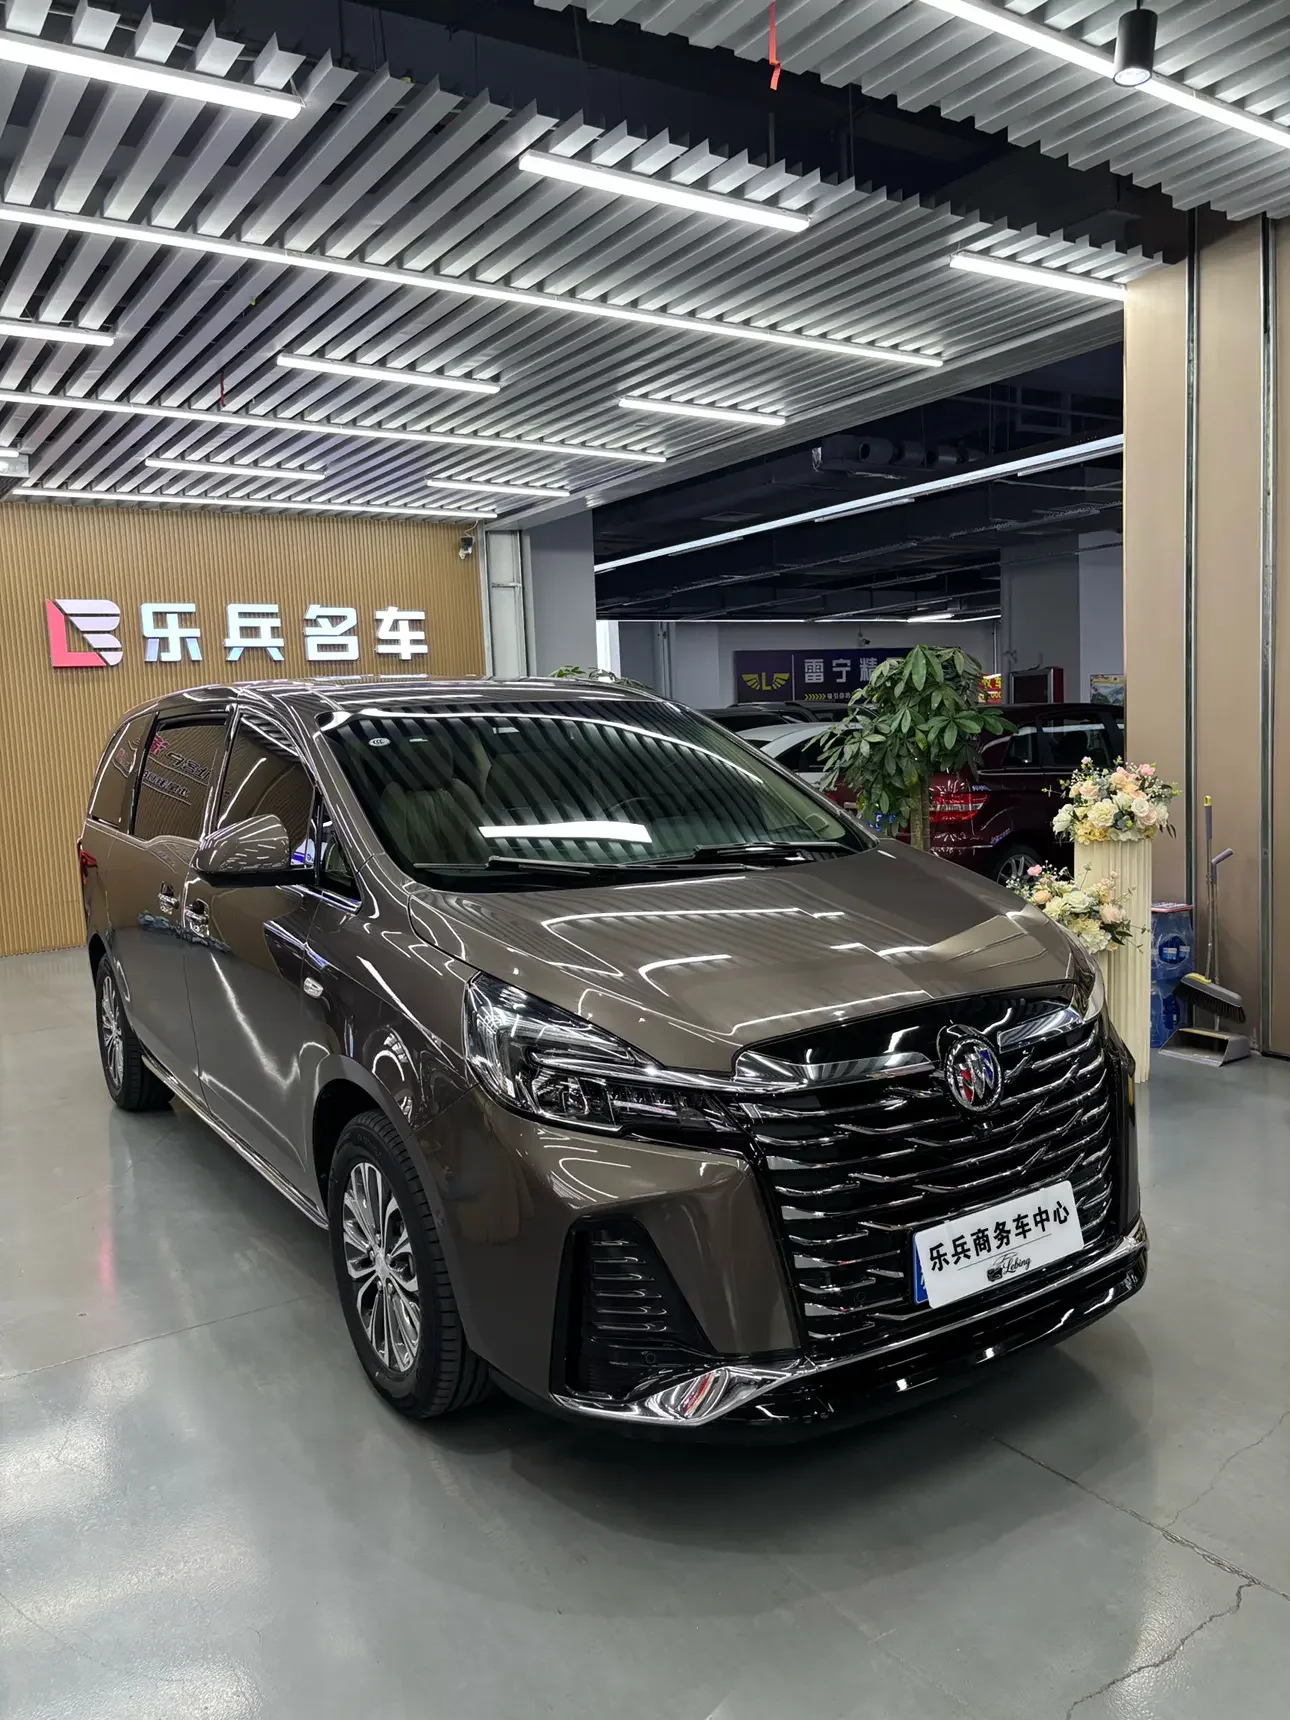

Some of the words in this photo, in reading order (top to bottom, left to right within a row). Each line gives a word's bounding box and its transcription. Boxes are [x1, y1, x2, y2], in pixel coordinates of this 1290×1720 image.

[140, 602, 429, 662] 乐兵名车
[804, 657, 904, 684] 雷宁精
[929, 1200, 1070, 1272] 乐兵商务车中心
